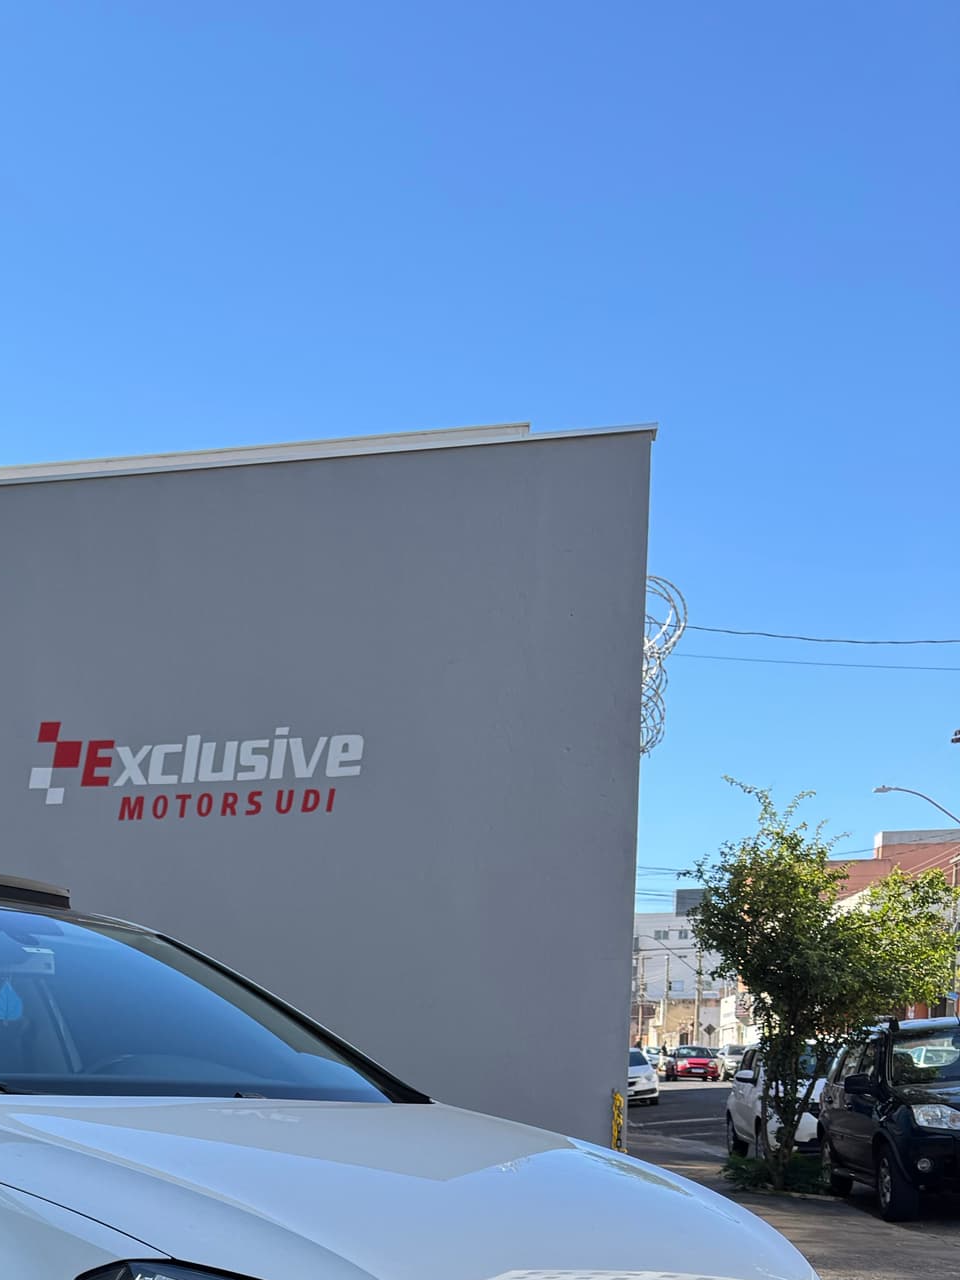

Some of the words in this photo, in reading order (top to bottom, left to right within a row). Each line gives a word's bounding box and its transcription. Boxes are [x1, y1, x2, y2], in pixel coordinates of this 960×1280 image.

[80, 727, 364, 787] Exclusive
[118, 791, 262, 821] MOTORS
[275, 788, 336, 814] UDI
